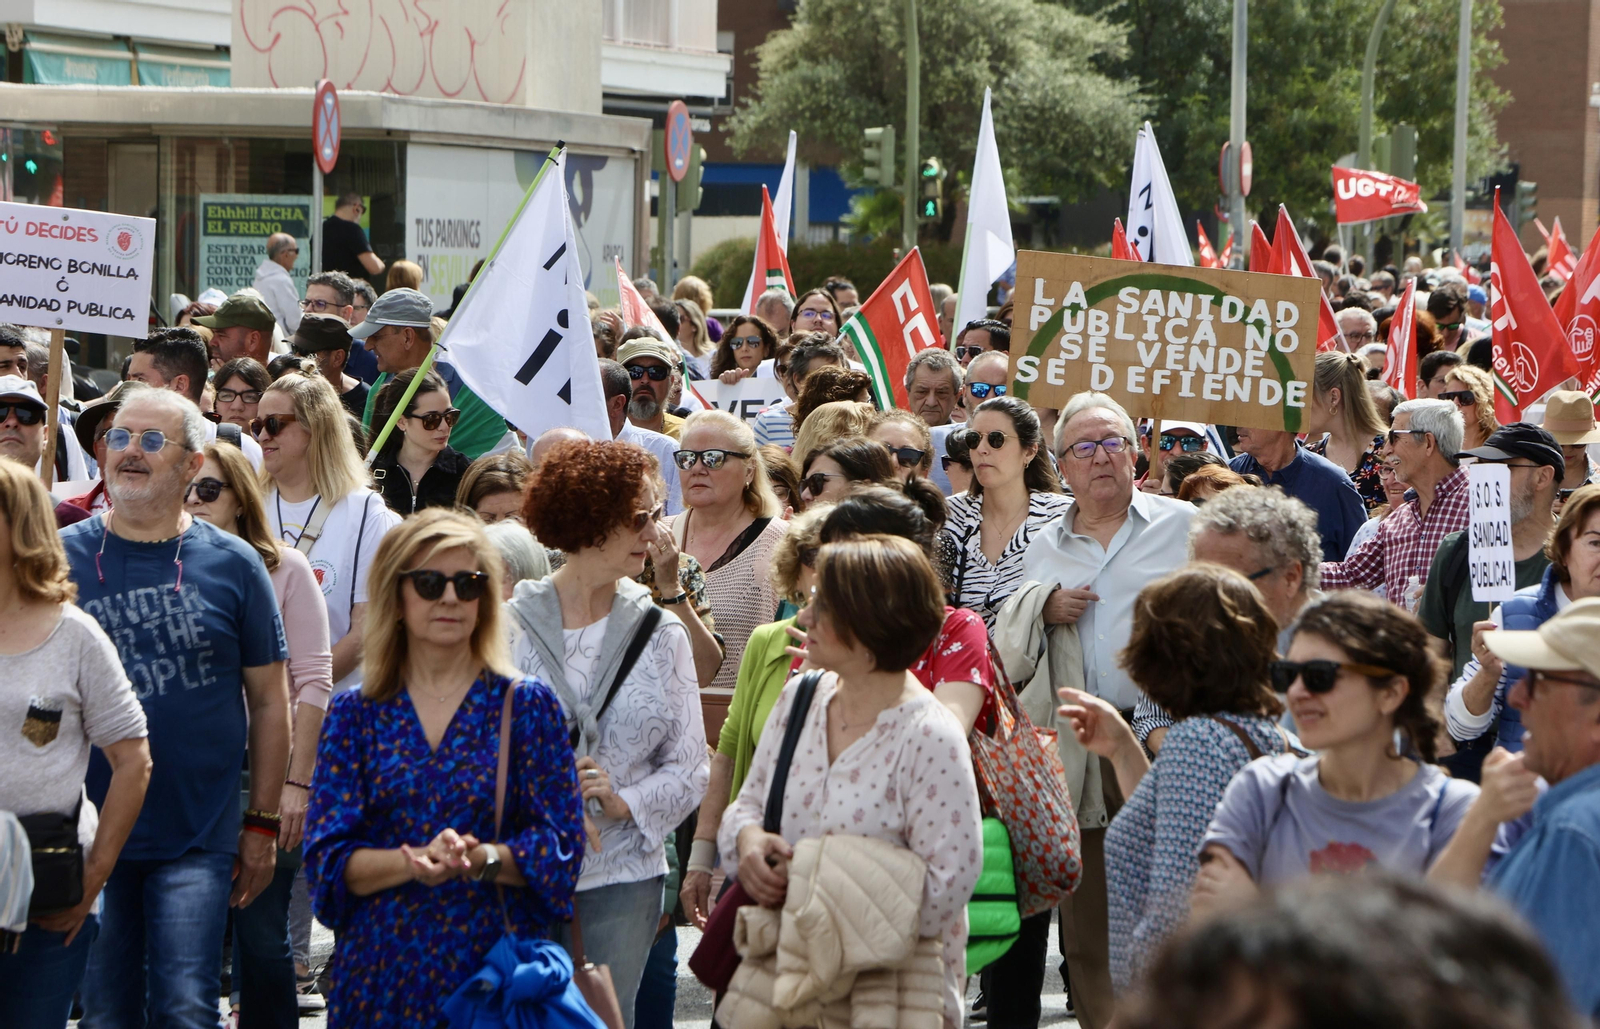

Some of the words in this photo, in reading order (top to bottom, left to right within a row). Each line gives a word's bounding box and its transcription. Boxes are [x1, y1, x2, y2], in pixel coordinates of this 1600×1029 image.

[1337, 177, 1394, 200] UGT
[207, 205, 258, 219] Ehhh!!!
[261, 206, 304, 220] ECHA
[25, 221, 99, 242] DECIDES
[207, 221, 227, 234] EL
[229, 222, 282, 234] FRENO
[416, 218, 434, 248] TUS
[435, 218, 481, 249] PARKINGS
[207, 244, 238, 254] ESTE
[240, 245, 267, 255] PAR
[207, 255, 257, 266] CUENTA
[0, 251, 62, 271] ORENO
[67, 258, 139, 280] BONILLA
[207, 266, 232, 276] CON
[235, 267, 254, 276] UN
[207, 277, 232, 287] DON
[0, 293, 61, 312] ANIDAD
[67, 300, 135, 321] PUBLICA
[1034, 278, 1088, 309] LA
[1117, 286, 1300, 329] SANIDAD
[1029, 305, 1217, 347] PUBLICA
[1245, 323, 1299, 353] NO
[1059, 333, 1106, 364] SE
[1136, 341, 1266, 378] VENDE
[1015, 355, 1065, 386] SE
[1090, 364, 1307, 408] DEFIENDE
[1472, 521, 1509, 549] SANIDAD
[1471, 555, 1512, 588] PÚBLICA!
[84, 582, 206, 630] OWDER
[142, 611, 212, 655] THE
[131, 649, 217, 700] OPLE
